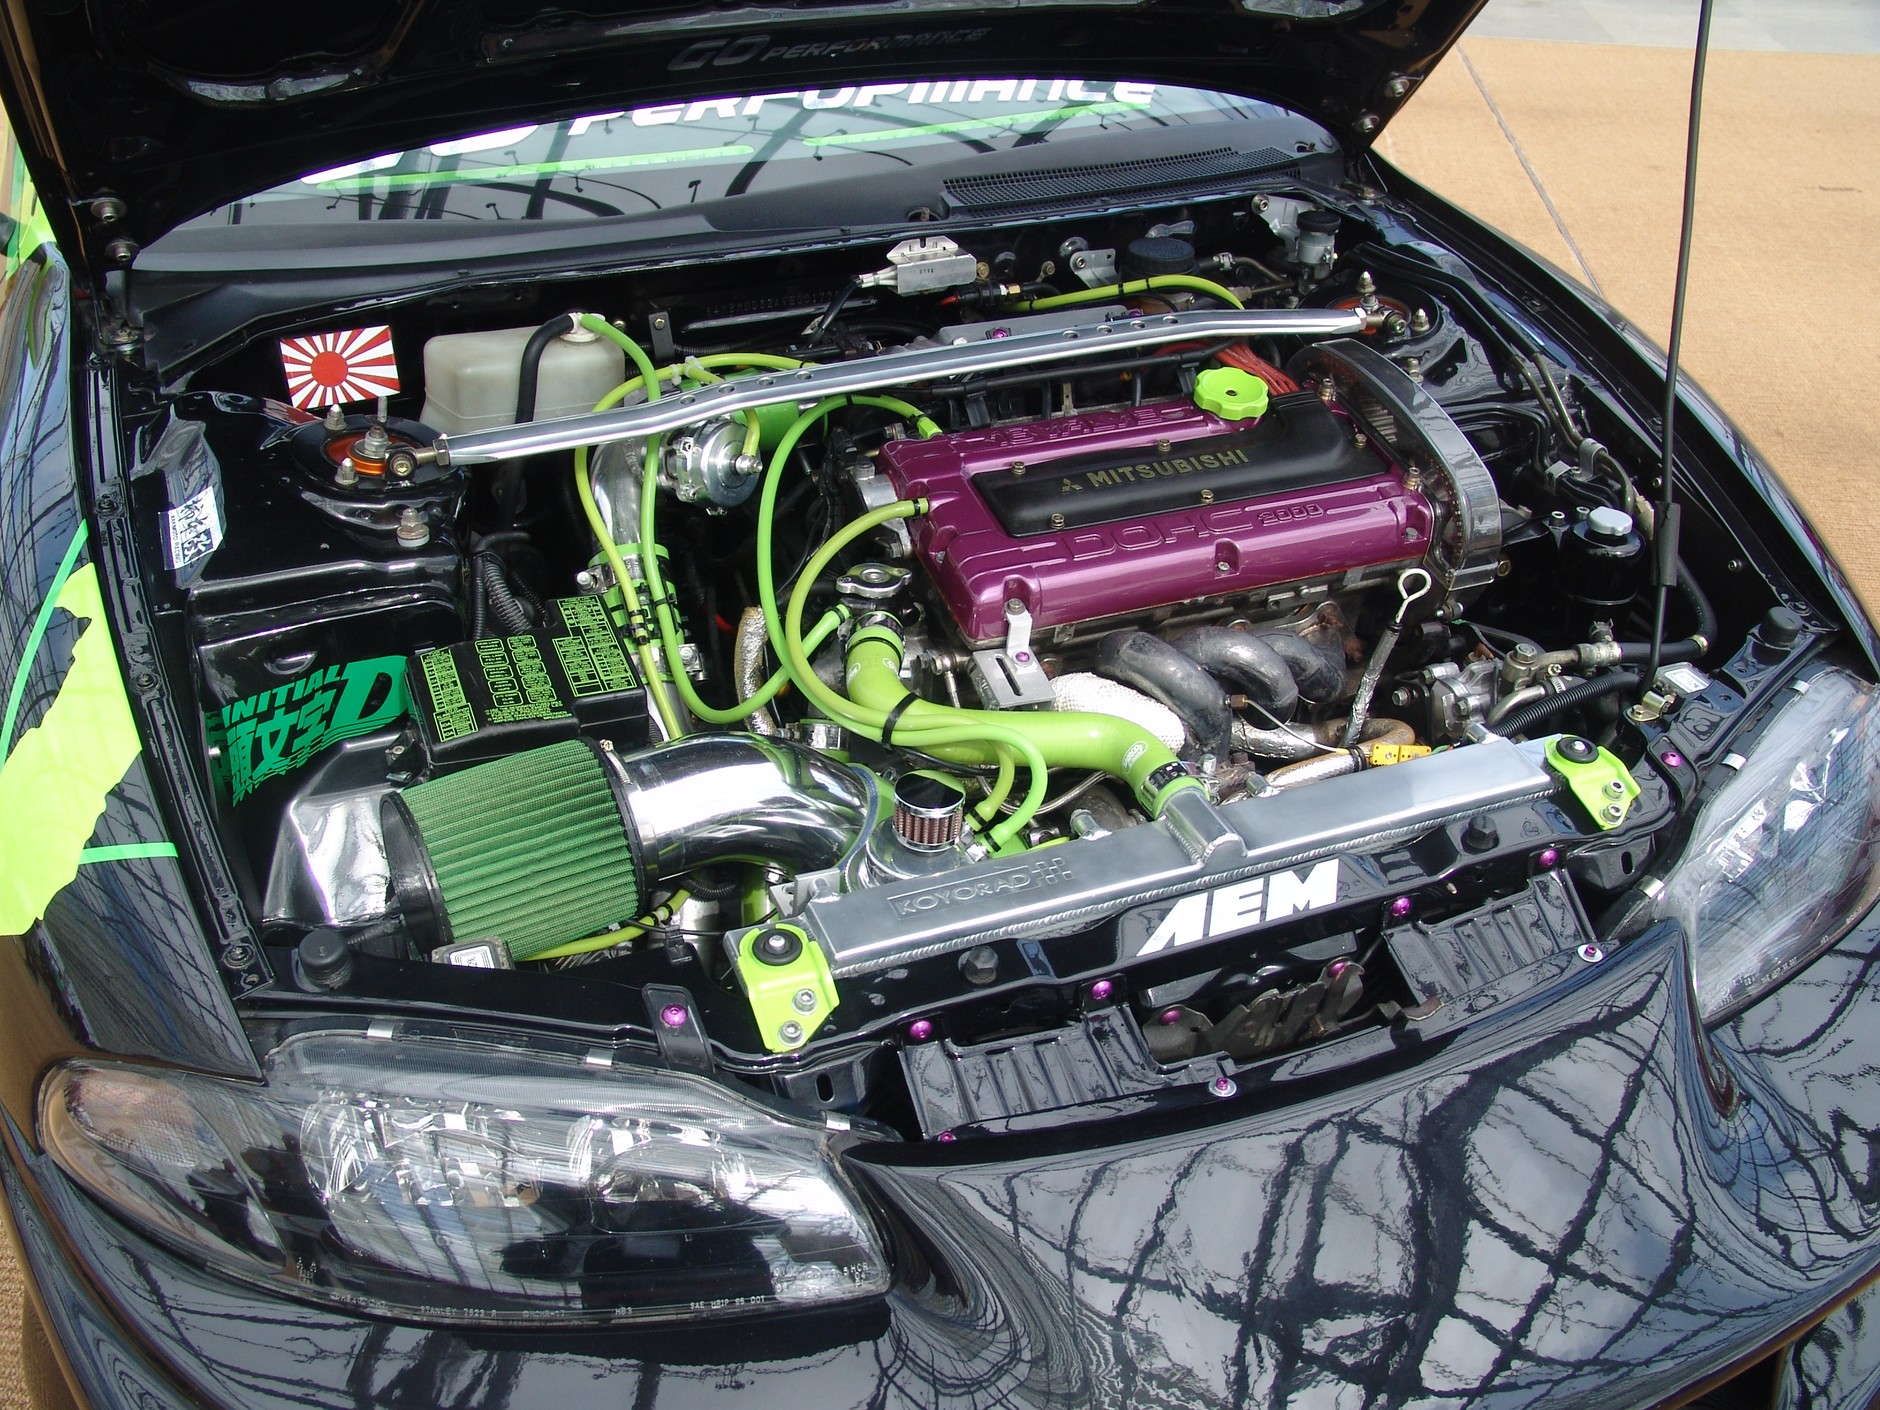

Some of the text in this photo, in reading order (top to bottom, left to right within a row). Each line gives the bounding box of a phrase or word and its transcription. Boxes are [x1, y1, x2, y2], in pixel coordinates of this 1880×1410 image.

[667, 27, 992, 72] GO PERFORMANCE
[1086, 449, 1249, 488] MITSUBISHI
[1062, 503, 1324, 561] DOHC 2000
[222, 664, 341, 728] INITIAL
[895, 873, 1032, 915] KOYORAD
[1136, 858, 1340, 957] AEM
[420, 1305, 456, 1316] STANLEY
